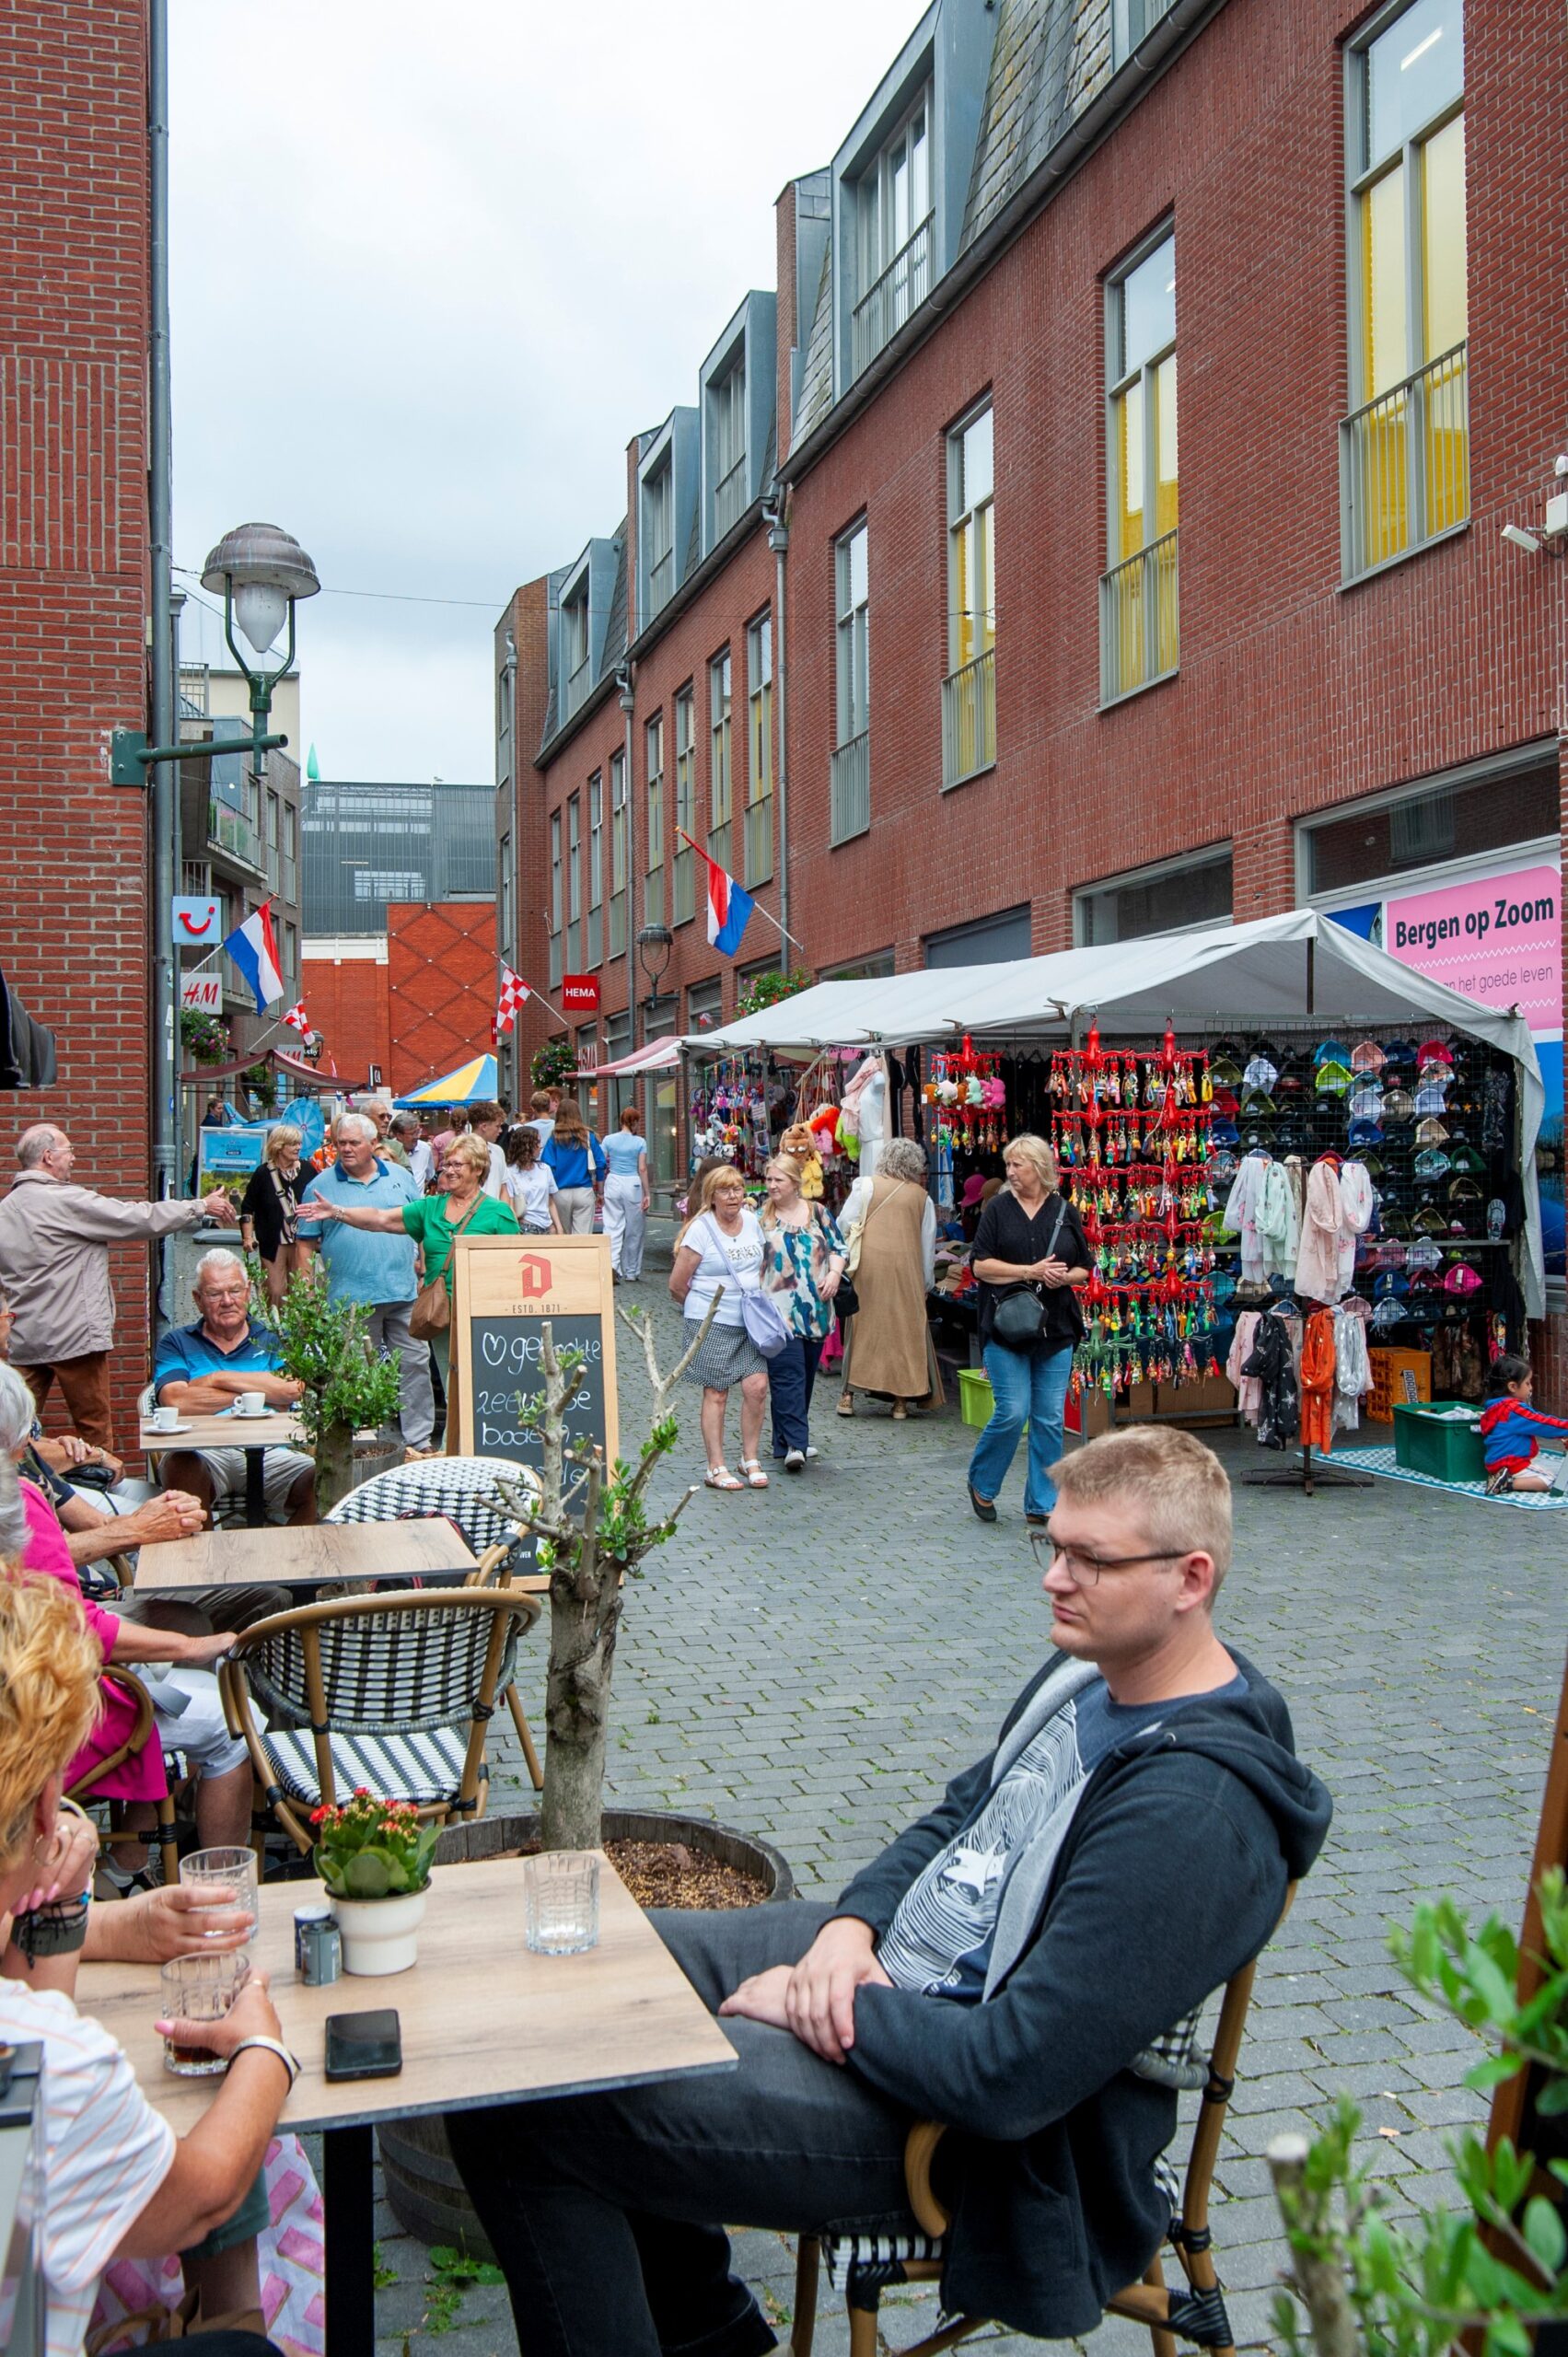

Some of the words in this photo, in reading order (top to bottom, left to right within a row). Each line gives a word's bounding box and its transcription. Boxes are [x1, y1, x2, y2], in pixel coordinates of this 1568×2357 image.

[1396, 912, 1459, 949] Bergen
[1465, 910, 1489, 939] op
[1494, 897, 1554, 929] Zoom
[565, 987, 596, 997] HEMA
[1458, 973, 1477, 993] het
[1480, 970, 1517, 993] goede
[1520, 967, 1553, 983] leven
[183, 981, 219, 1005] H&M
[512, 1305, 537, 1314] ESTD.
[541, 1304, 561, 1313] 1871
